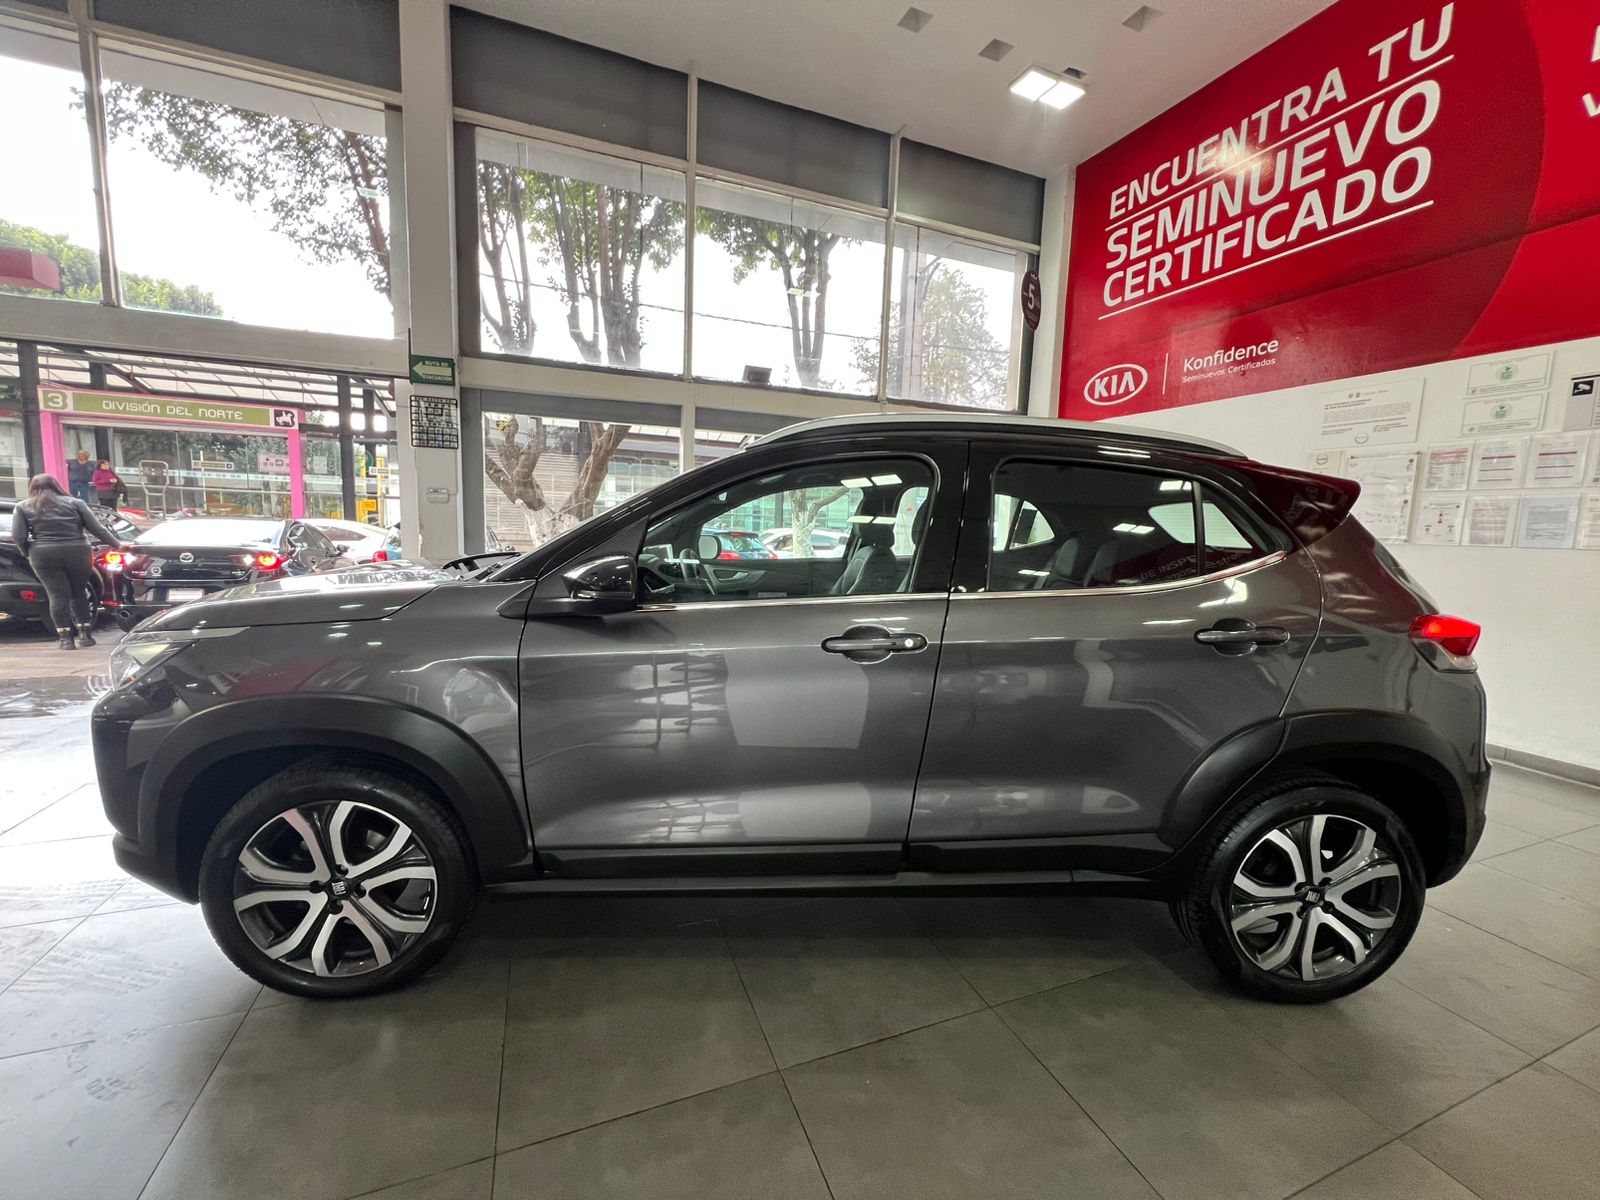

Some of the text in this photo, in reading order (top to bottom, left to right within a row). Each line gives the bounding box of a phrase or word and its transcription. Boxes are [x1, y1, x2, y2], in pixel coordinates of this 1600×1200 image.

[1109, 2, 1454, 220] ENCUENTRA TU
[1106, 79, 1441, 269] SEMINUEVO
[1103, 146, 1432, 307] CERTIFICADO
[1182, 358, 1276, 384] Seminuevos Certificados
[1183, 339, 1279, 373] Konfidence
[48, 393, 64, 407] 3
[1094, 371, 1136, 400] KIA
[102, 400, 244, 420] DIVISIÓN DEL NORTE
